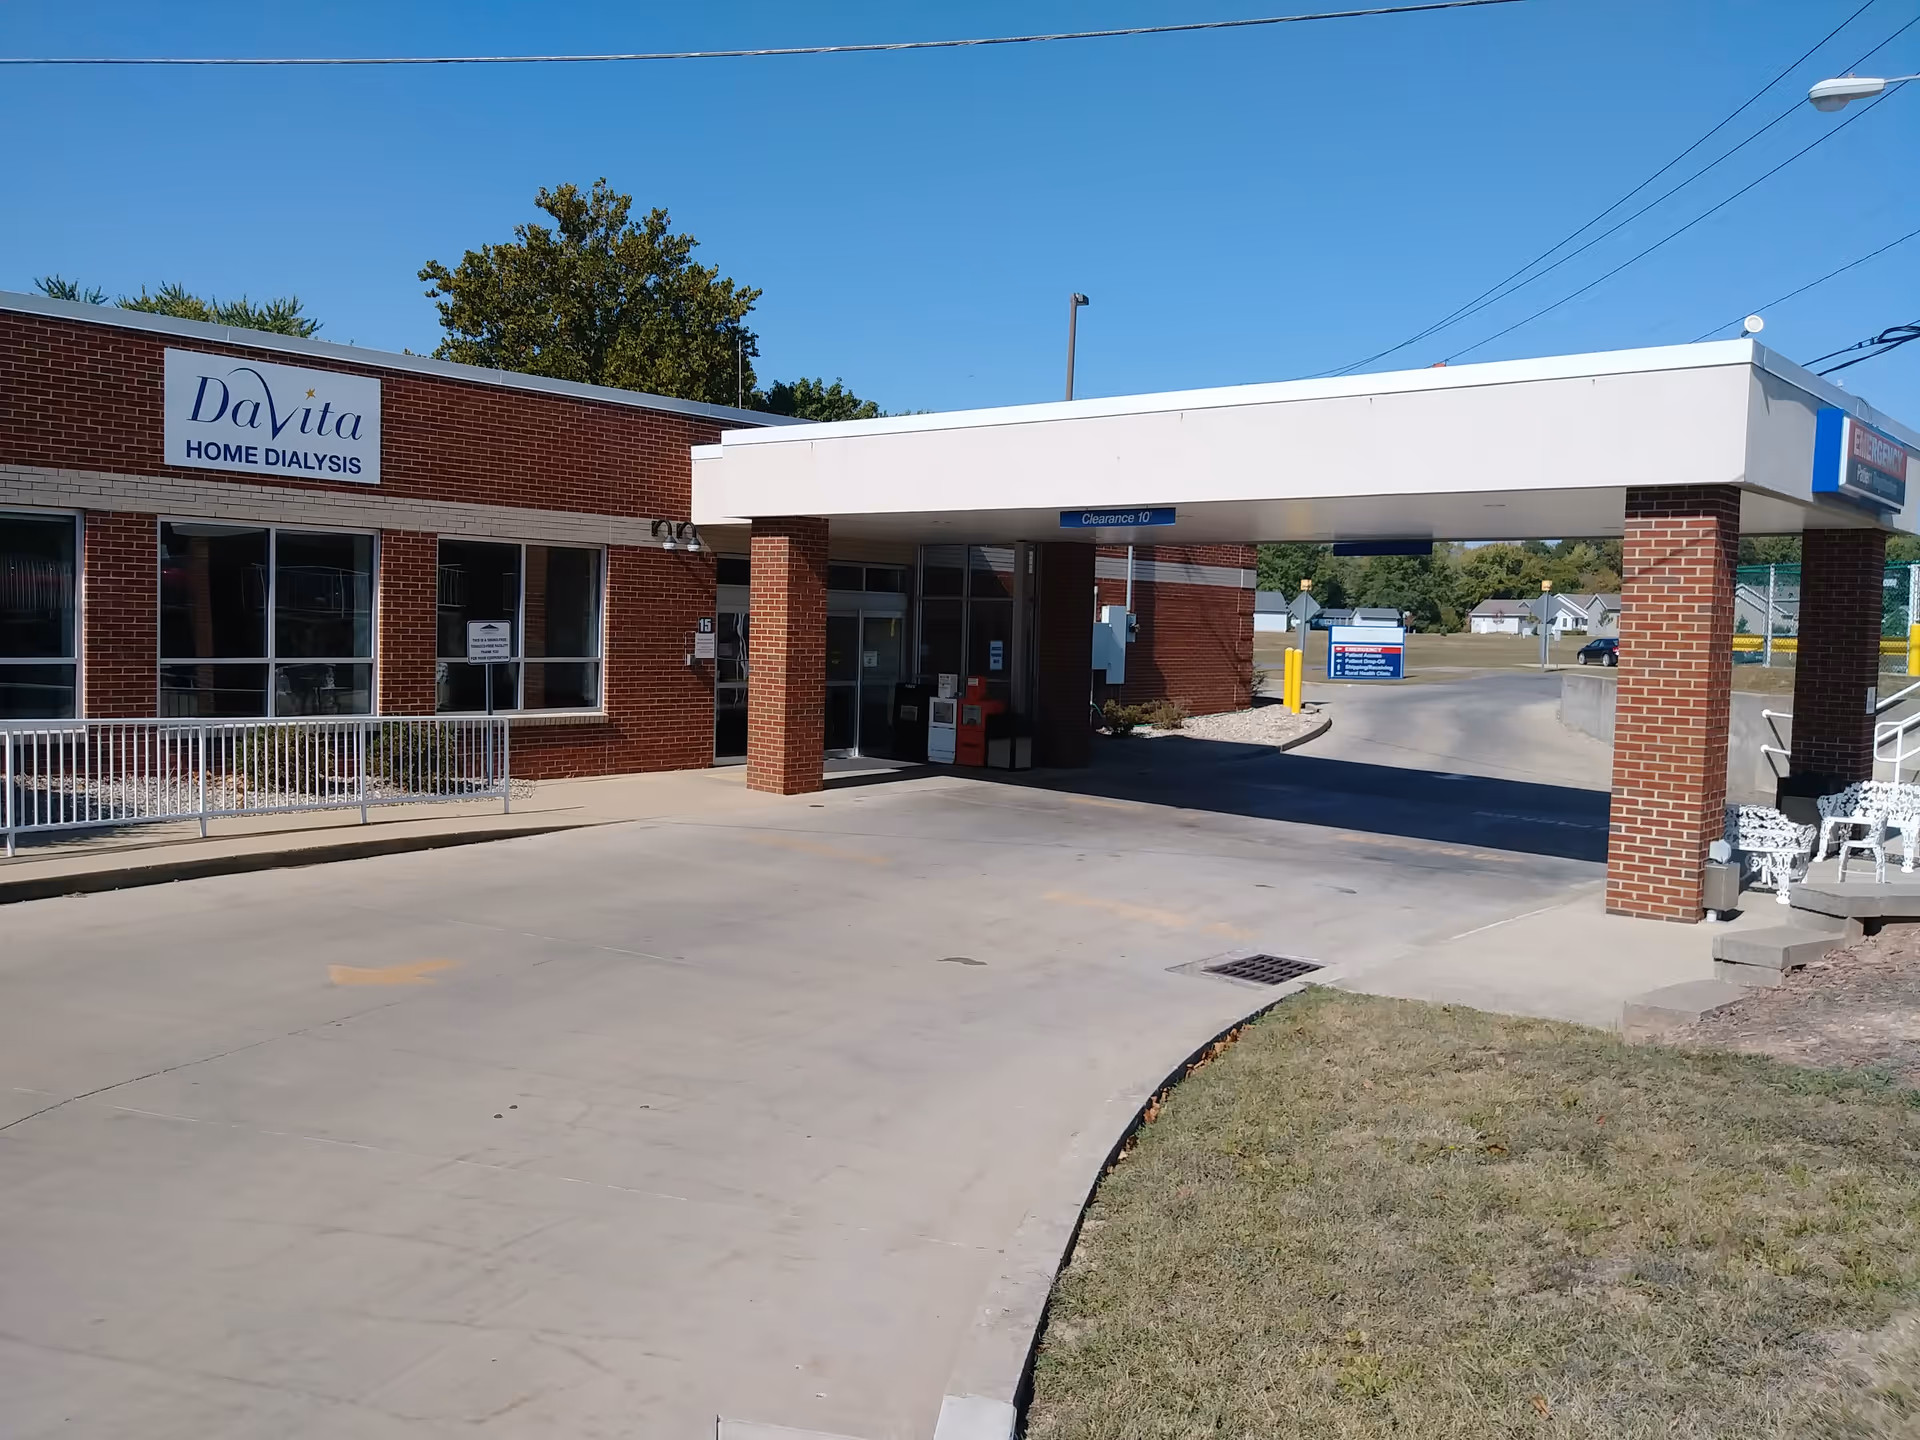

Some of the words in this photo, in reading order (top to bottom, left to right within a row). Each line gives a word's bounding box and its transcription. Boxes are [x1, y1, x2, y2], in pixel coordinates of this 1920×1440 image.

[186, 367, 362, 441] DaVita
[186, 440, 258, 464] HOME
[265, 448, 362, 474] DIALYSIS
[1854, 427, 1904, 474] EMERGENCY
[1082, 513, 1135, 525] Clearance
[700, 619, 711, 632] 15
